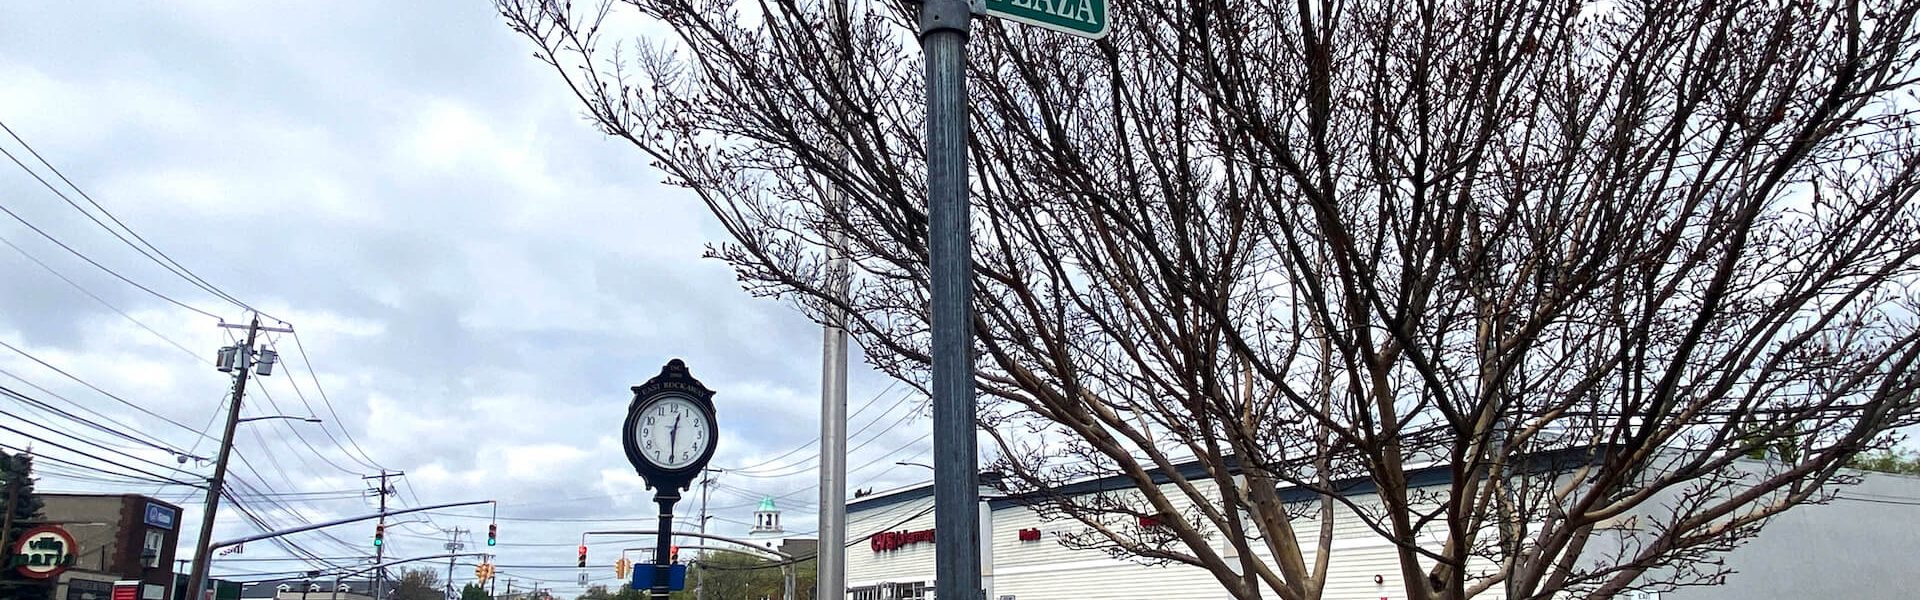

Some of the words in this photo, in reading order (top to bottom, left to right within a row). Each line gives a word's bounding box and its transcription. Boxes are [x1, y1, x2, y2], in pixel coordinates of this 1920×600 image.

[658, 407, 665, 416] 11
[670, 403, 679, 413] 12
[685, 408, 689, 418] 1
[646, 416, 655, 425] 10
[693, 418, 699, 428] 2
[643, 428, 649, 438] 9
[697, 430, 702, 440] 3
[646, 440, 652, 449] 8
[692, 442, 698, 451] 4
[655, 450, 661, 461] 7
[683, 451, 689, 460] 5
